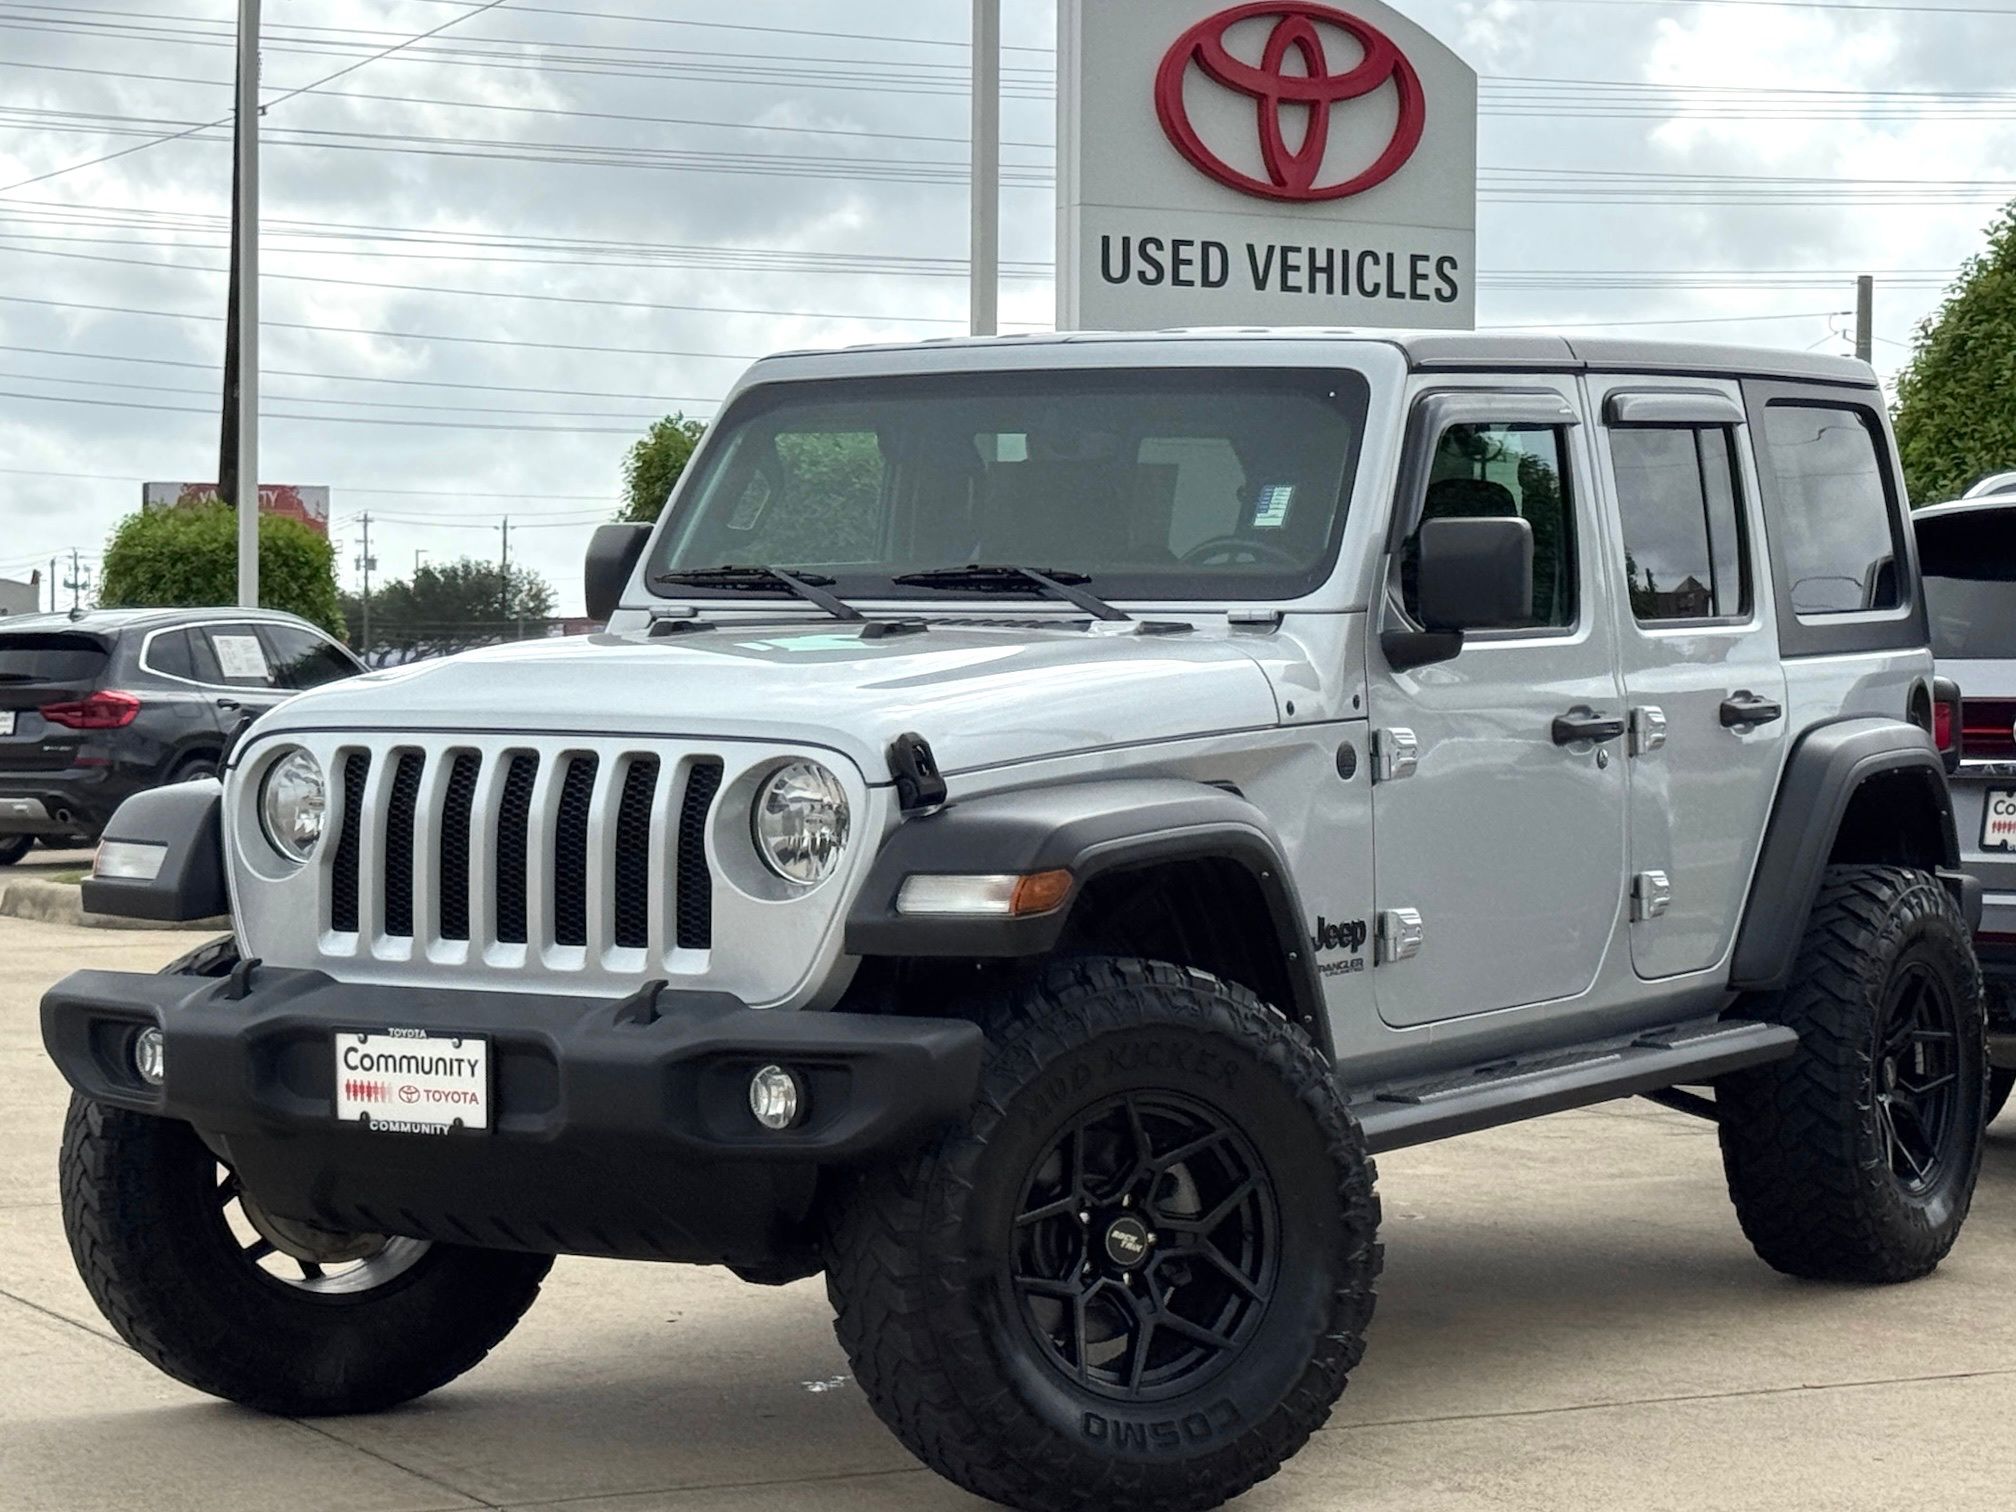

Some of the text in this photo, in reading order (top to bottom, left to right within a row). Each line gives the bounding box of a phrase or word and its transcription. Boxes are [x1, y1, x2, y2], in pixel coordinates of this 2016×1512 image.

[1100, 234, 1459, 303] USED VEHICLES
[1311, 915, 1366, 954] Jeep
[1317, 957, 1364, 973] RANGLER
[387, 1027, 428, 1039] TOYOTA
[423, 1088, 480, 1105] TOYOTA
[369, 1119, 451, 1136] COMMUNITY
[1082, 1398, 1243, 1451] COSMO
